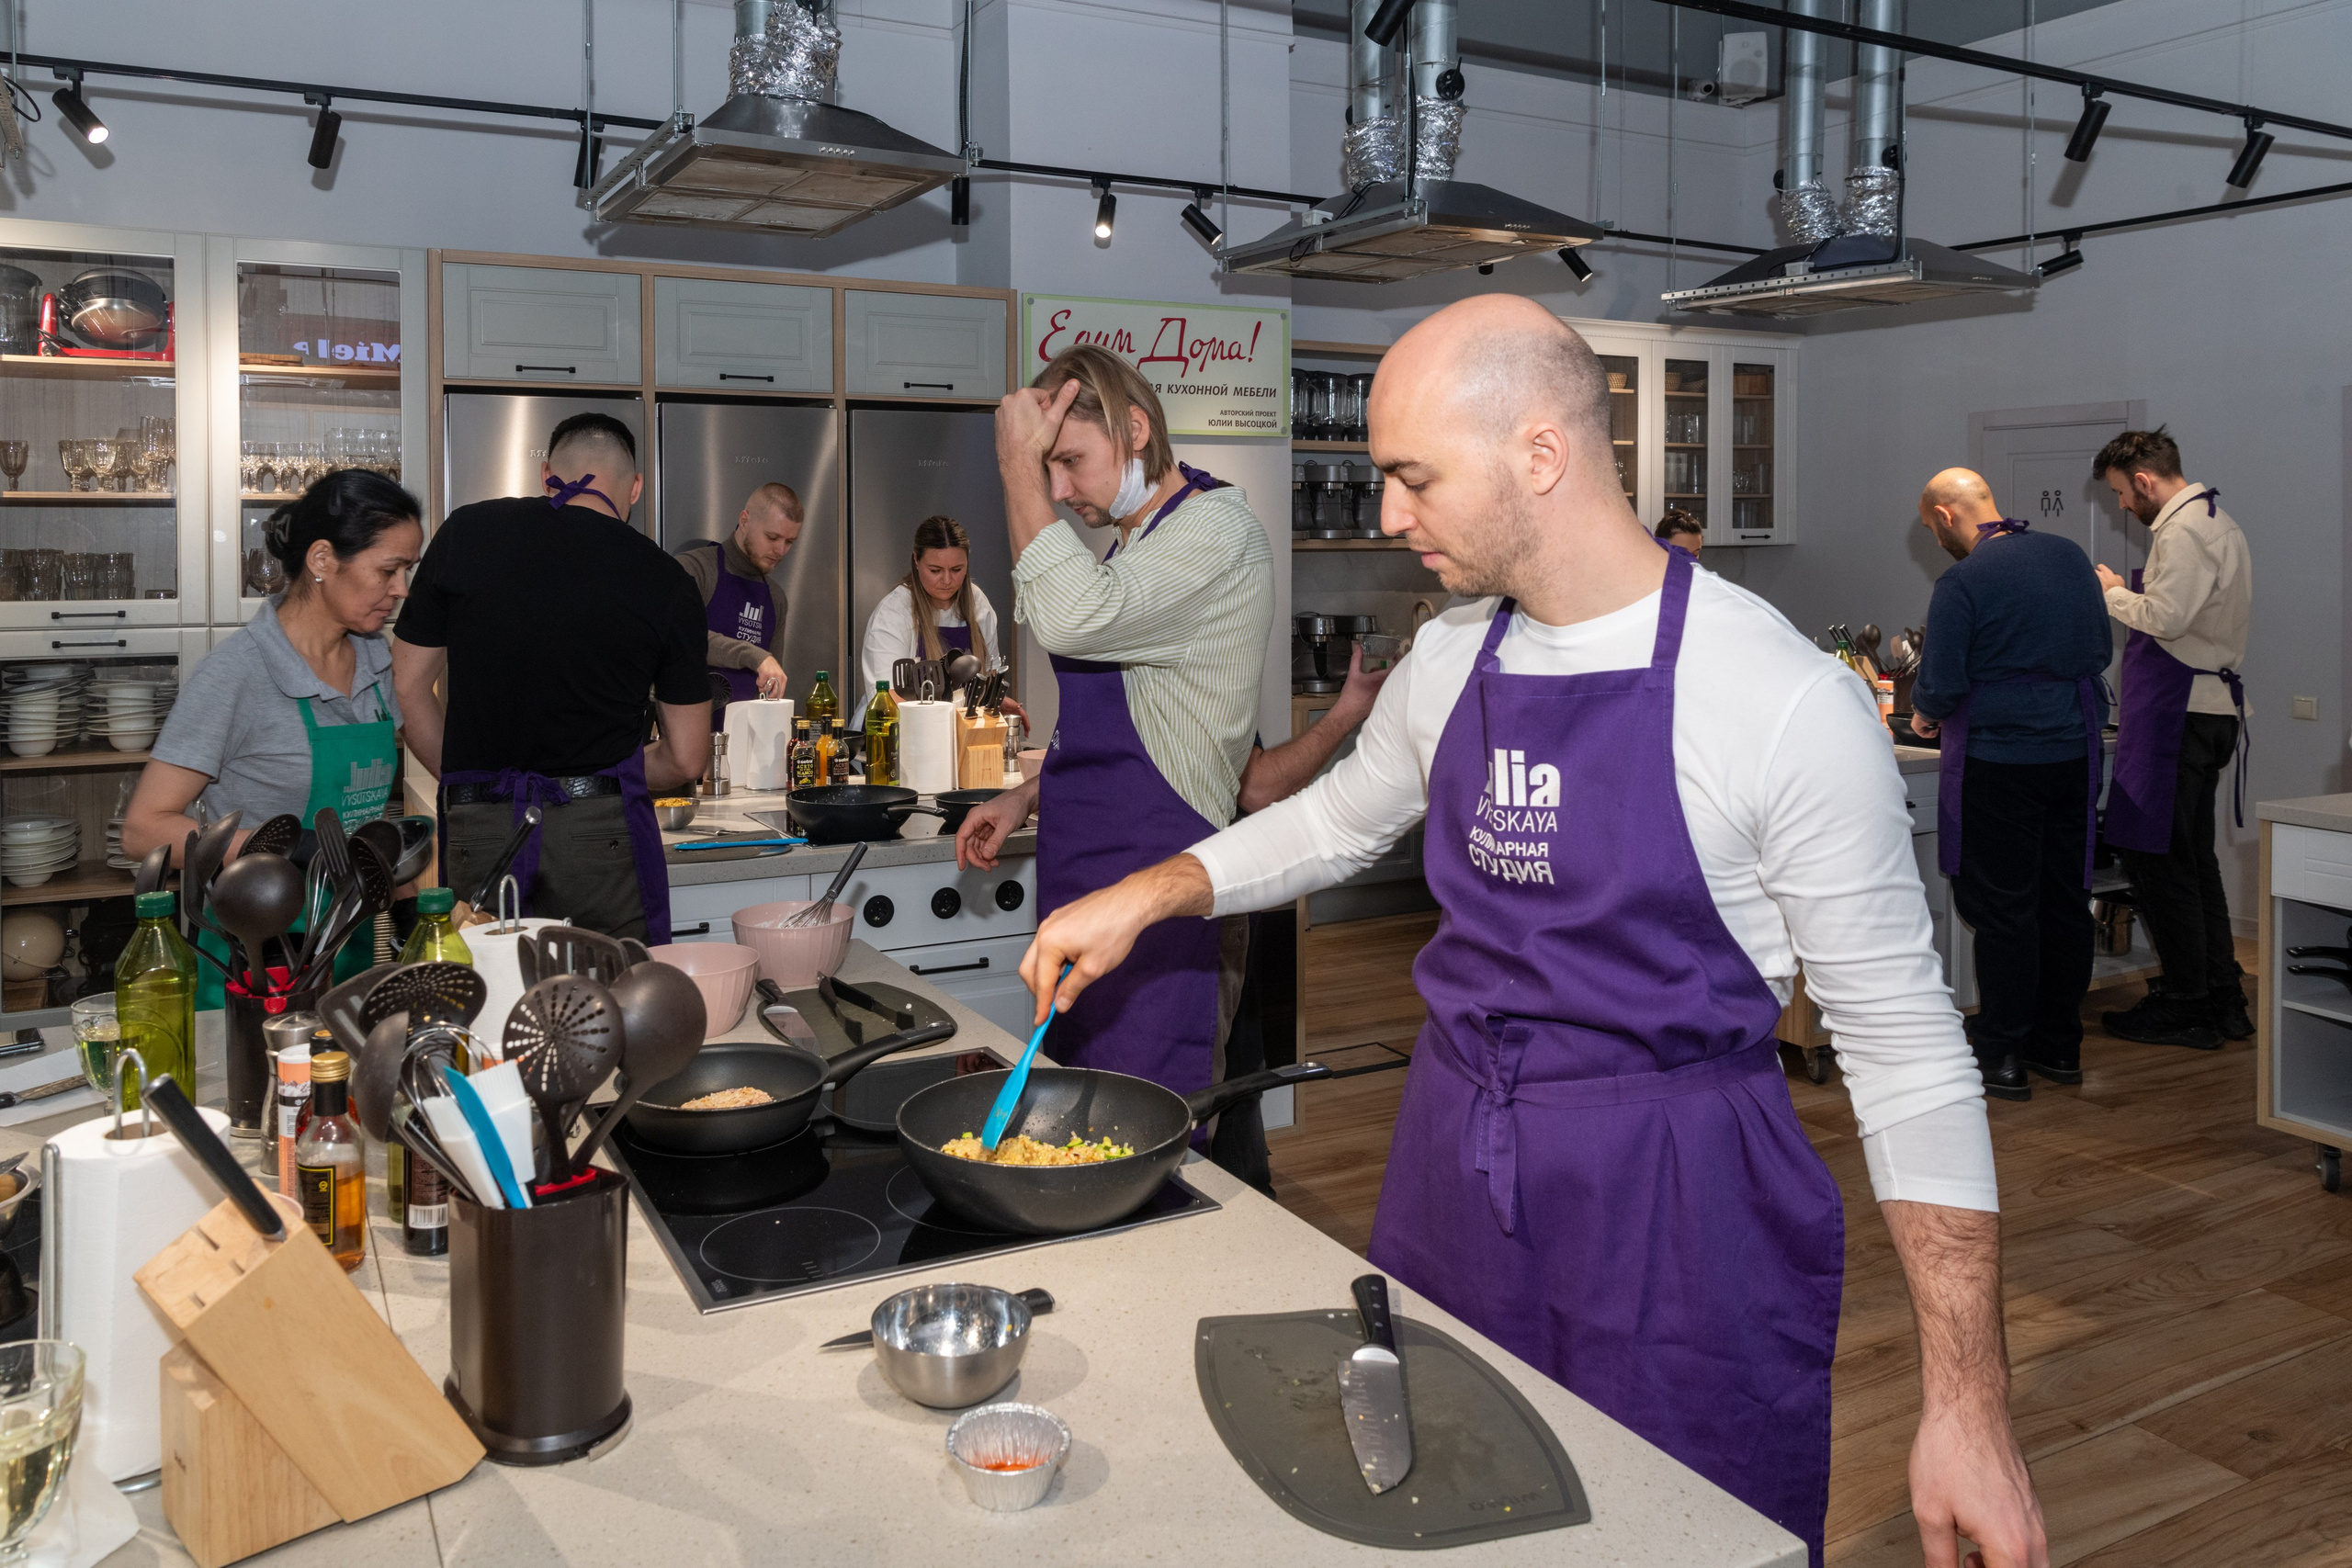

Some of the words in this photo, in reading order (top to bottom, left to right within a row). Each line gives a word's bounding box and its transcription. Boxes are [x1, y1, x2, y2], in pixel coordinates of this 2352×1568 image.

[1136, 318, 1262, 378] Дома!
[1167, 384, 1228, 396] КУХОННОЙ
[1232, 387, 1277, 398] МЕБЕЛИ
[1208, 419, 1233, 427] ЮЛИИ
[1235, 419, 1277, 429] ВЫСОЦКОЙ
[1468, 843, 1555, 885] СТУДИЯ
